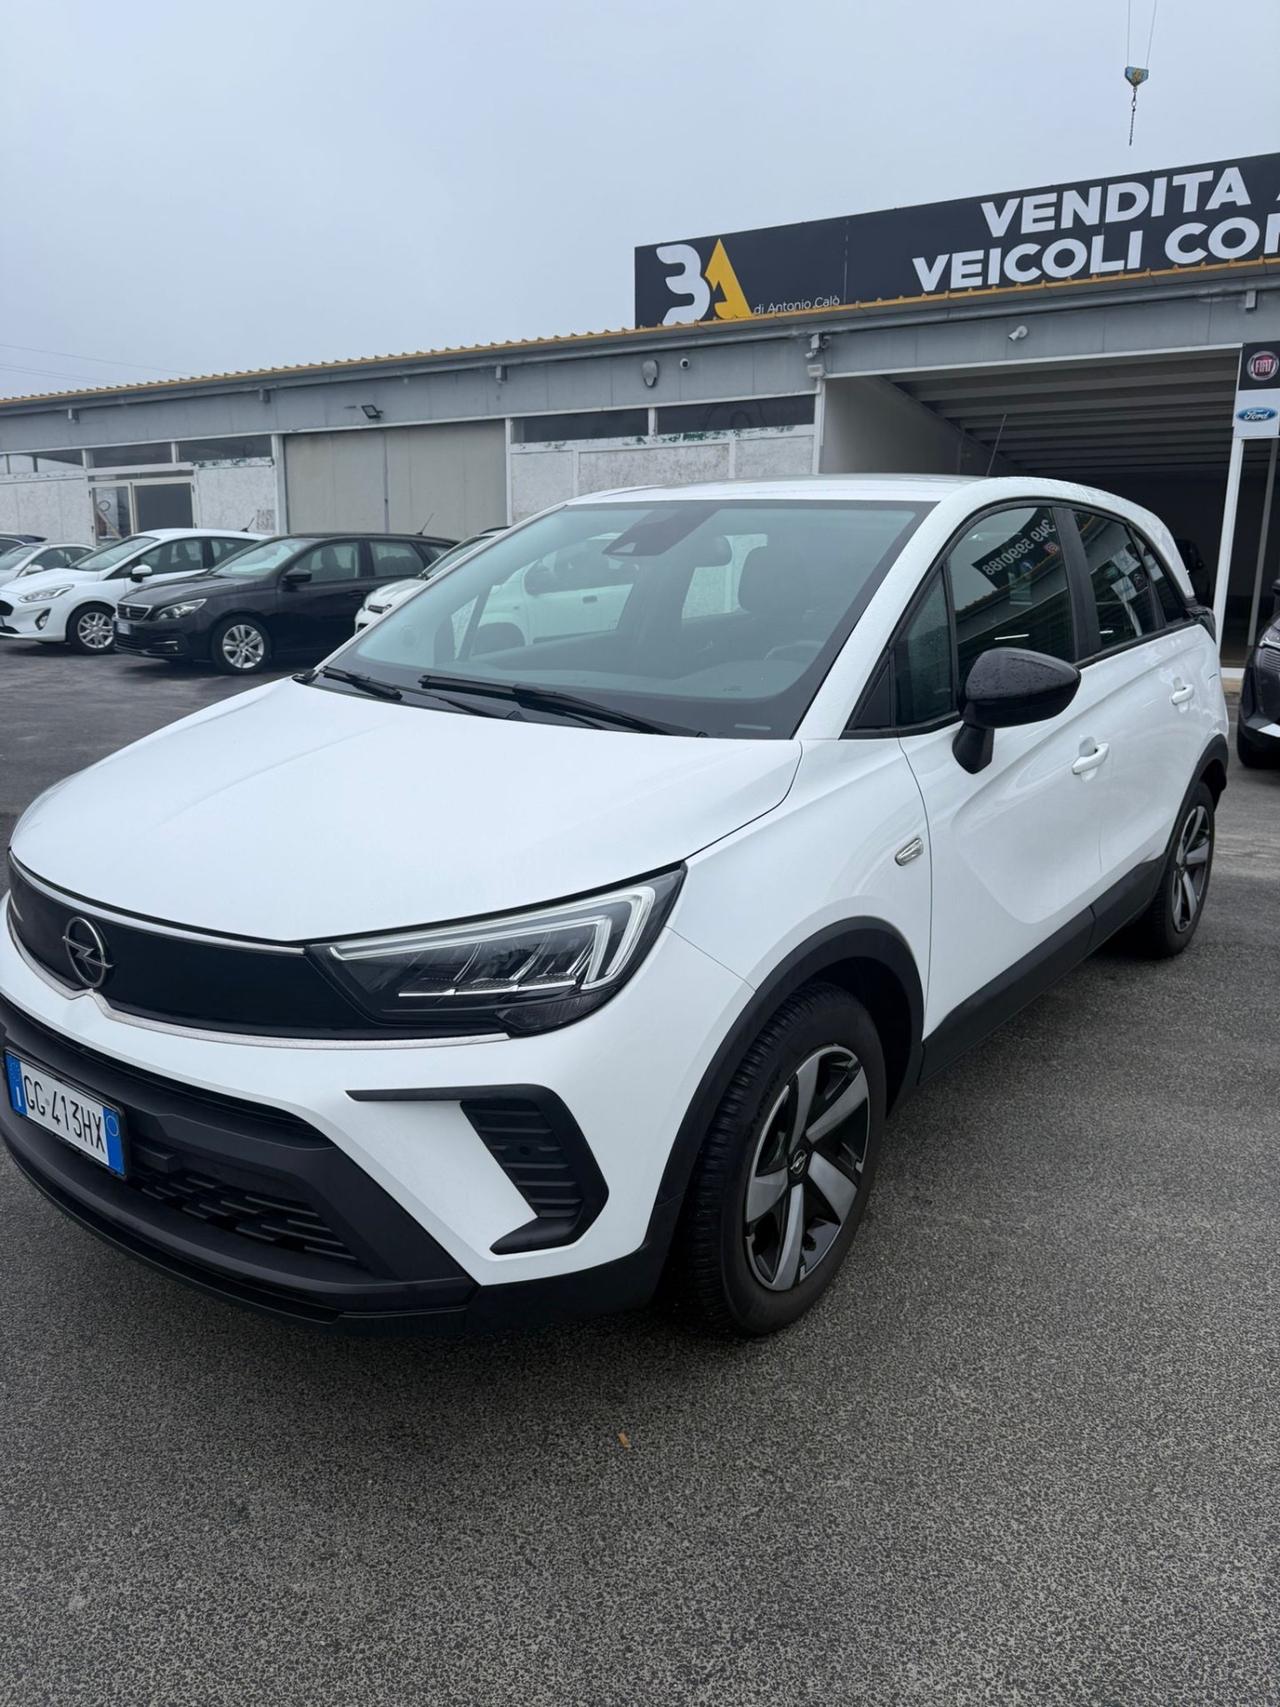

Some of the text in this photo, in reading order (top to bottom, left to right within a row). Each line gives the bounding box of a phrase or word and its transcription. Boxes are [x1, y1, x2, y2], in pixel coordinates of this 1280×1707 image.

[981, 167, 1251, 237] VENDITA
[912, 229, 1143, 292] VEICOLI
[767, 299, 812, 313] Antonio
